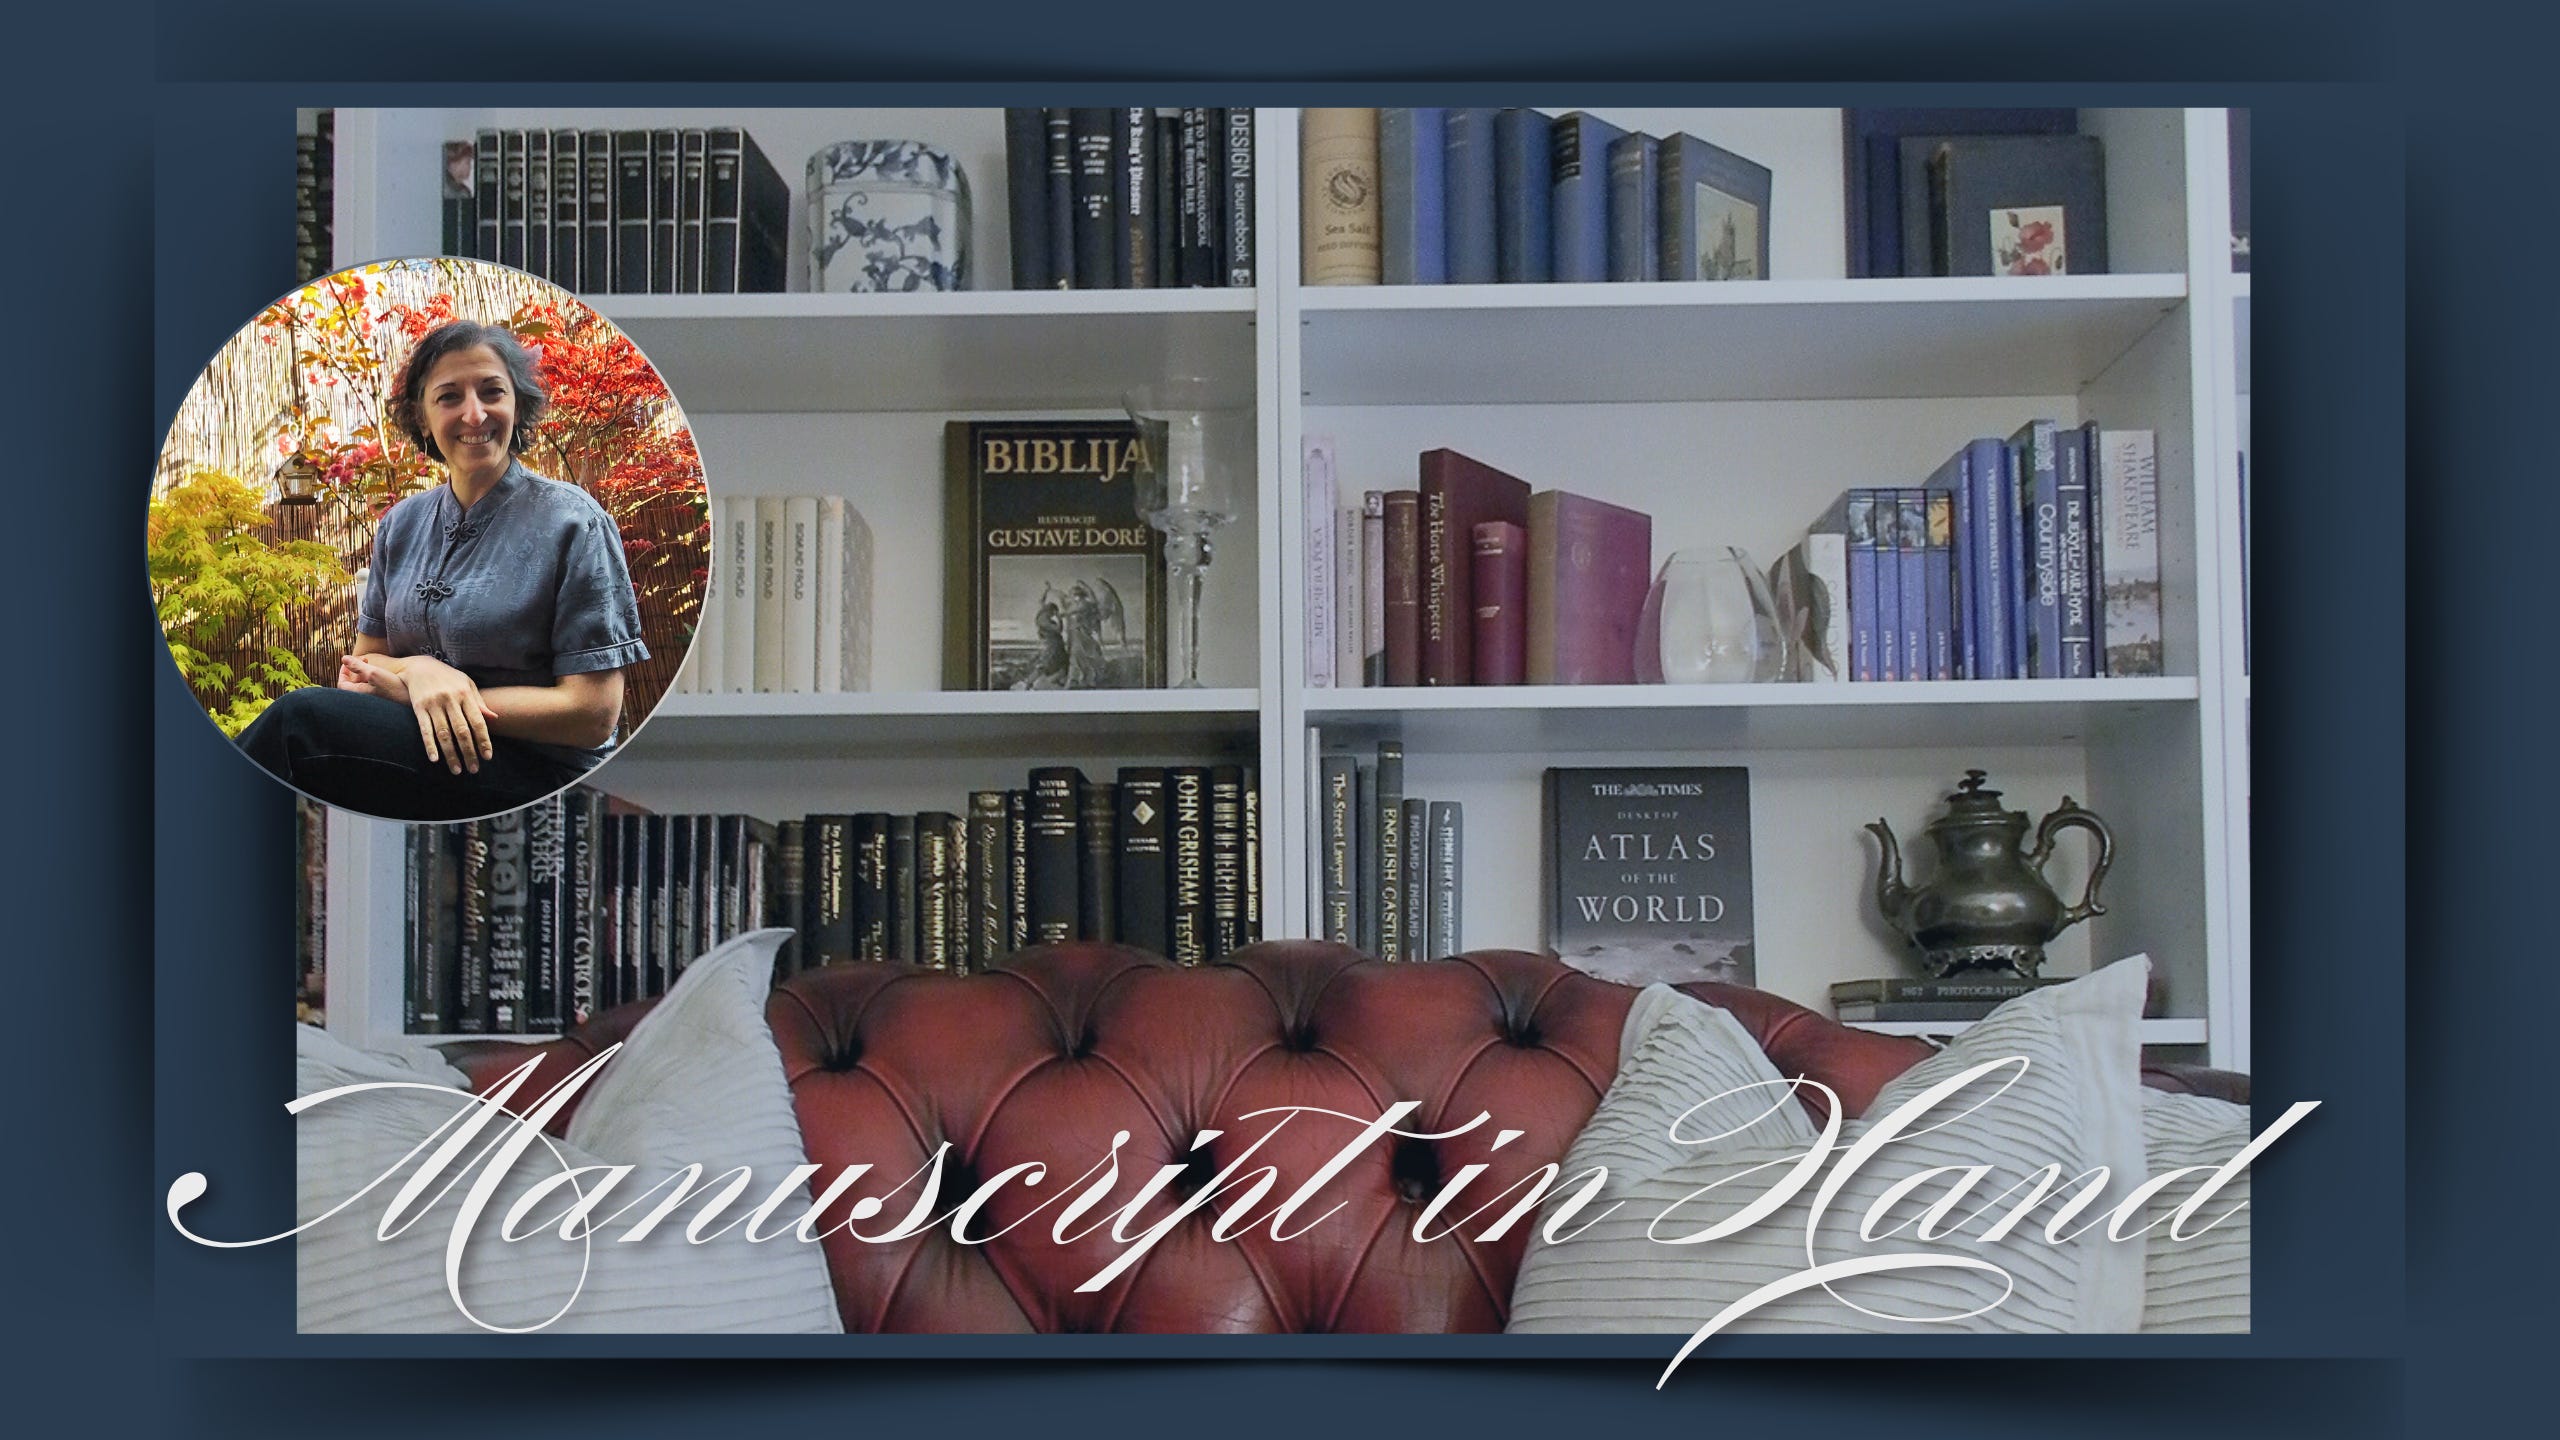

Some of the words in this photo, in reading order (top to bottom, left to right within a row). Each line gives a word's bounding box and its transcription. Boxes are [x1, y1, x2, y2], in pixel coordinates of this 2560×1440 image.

[1230, 114, 1250, 178] DESIGN
[1233, 181, 1250, 262] sourcebook
[1325, 224, 1345, 236] Sea
[984, 438, 1154, 483] BIBLIJA
[1429, 491, 1444, 518] The
[2122, 442, 2140, 550] SHAKESPEARE
[2139, 455, 2156, 534] WILLIAM
[988, 528, 1083, 547] GUSTAVE
[1085, 524, 1147, 547] DORÉ
[1429, 519, 1444, 564] Horse
[2036, 503, 2058, 606] Countryside
[1428, 564, 1445, 641] Whisperer
[2067, 592, 2083, 626] HYDE
[1173, 774, 1200, 823] JOHN
[1213, 783, 1238, 799] BY
[1333, 773, 1346, 799] The
[1591, 784, 1623, 796] THE
[1657, 783, 1704, 796] TIMES
[576, 812, 589, 838] The
[1012, 818, 1026, 851] JOHN
[1213, 802, 1238, 828] WAY
[1332, 801, 1346, 838] Street
[491, 810, 527, 911] ebel
[531, 800, 550, 884] ONVERTS
[871, 833, 886, 890] Stephen
[1213, 833, 1238, 848] OF
[1328, 840, 1346, 888] Lawyer
[1383, 808, 1397, 881] ENGLISH
[1409, 815, 1421, 869] ENGLAND
[1582, 833, 1716, 861] ATLAS
[463, 841, 488, 926] Elizabeth
[1012, 855, 1026, 913] GRISHAM
[1177, 827, 1200, 907] GRISHAM
[1213, 852, 1238, 918] DECEPTION
[1621, 873, 1641, 884] OF
[1647, 873, 1678, 884] THE
[1330, 901, 1347, 929] John
[1381, 886, 1397, 963] CASTLES
[1409, 883, 1420, 938] ENGLAND
[1576, 894, 1725, 923] WORLD
[574, 936, 594, 1016] CAROLS
[1937, 985, 2028, 998] PHOTOGRAPHY
